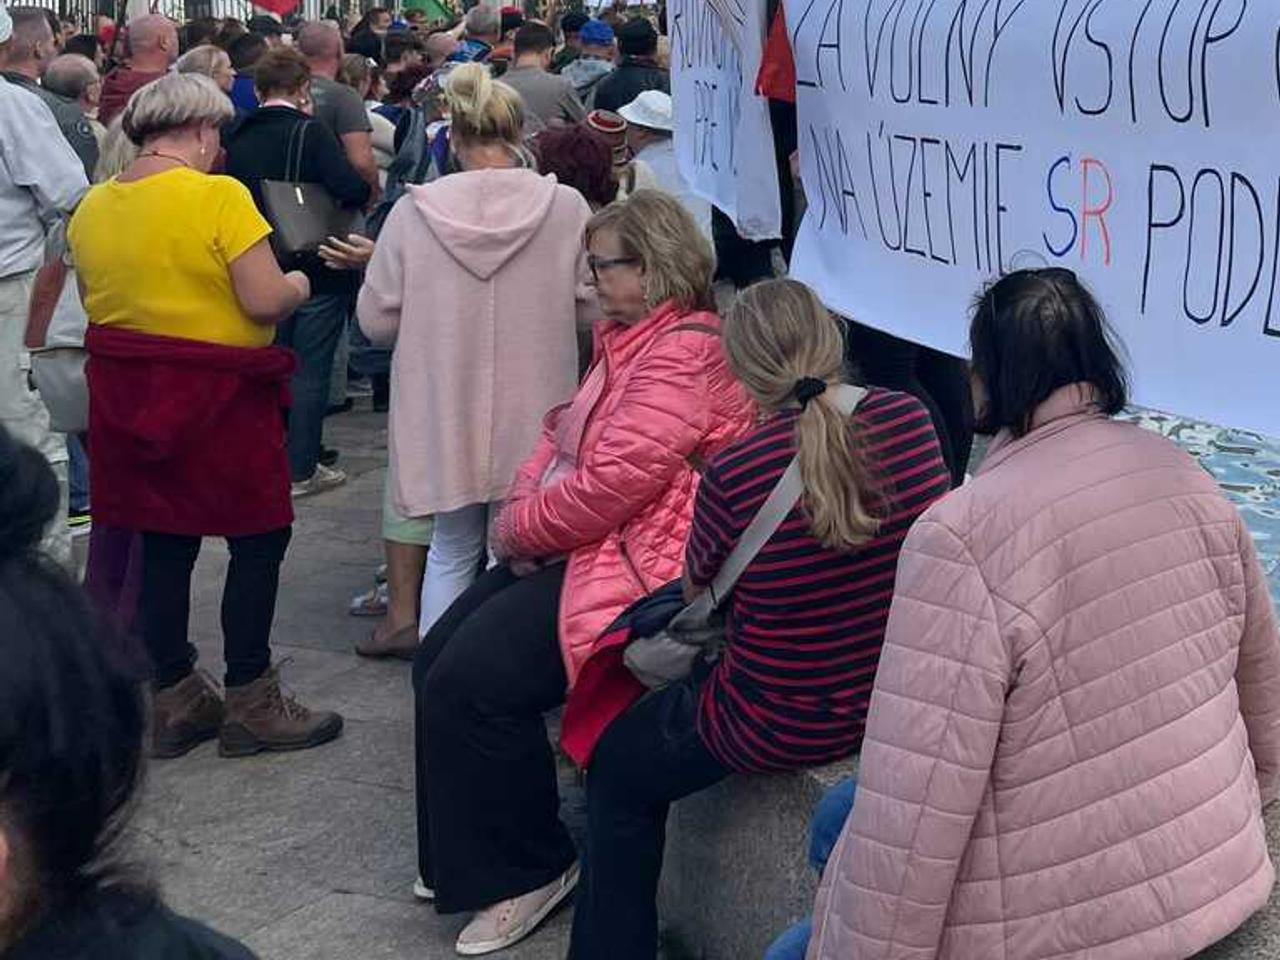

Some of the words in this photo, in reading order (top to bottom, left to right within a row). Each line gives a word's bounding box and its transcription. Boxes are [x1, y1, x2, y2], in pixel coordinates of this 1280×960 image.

[808, 124, 868, 241] NA
[866, 121, 1023, 276] ÚZEMIE
[1043, 155, 1116, 267] SR
